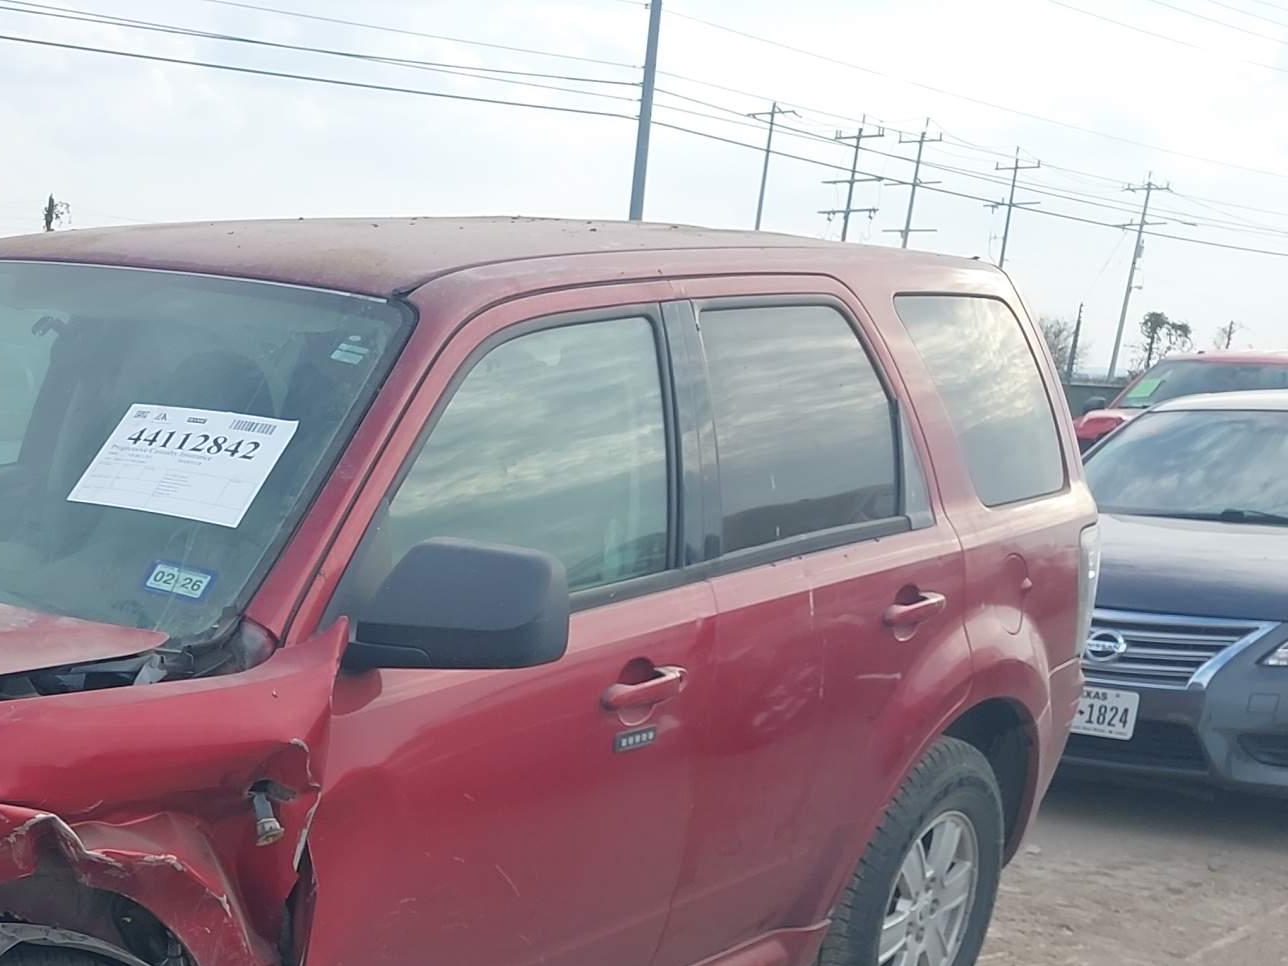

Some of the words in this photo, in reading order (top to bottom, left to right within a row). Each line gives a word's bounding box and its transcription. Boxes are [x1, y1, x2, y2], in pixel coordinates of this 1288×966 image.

[128, 427, 260, 460] 44112842
[153, 570, 175, 585] 02
[181, 577, 204, 592] 26
[1084, 703, 1129, 729] 1824
